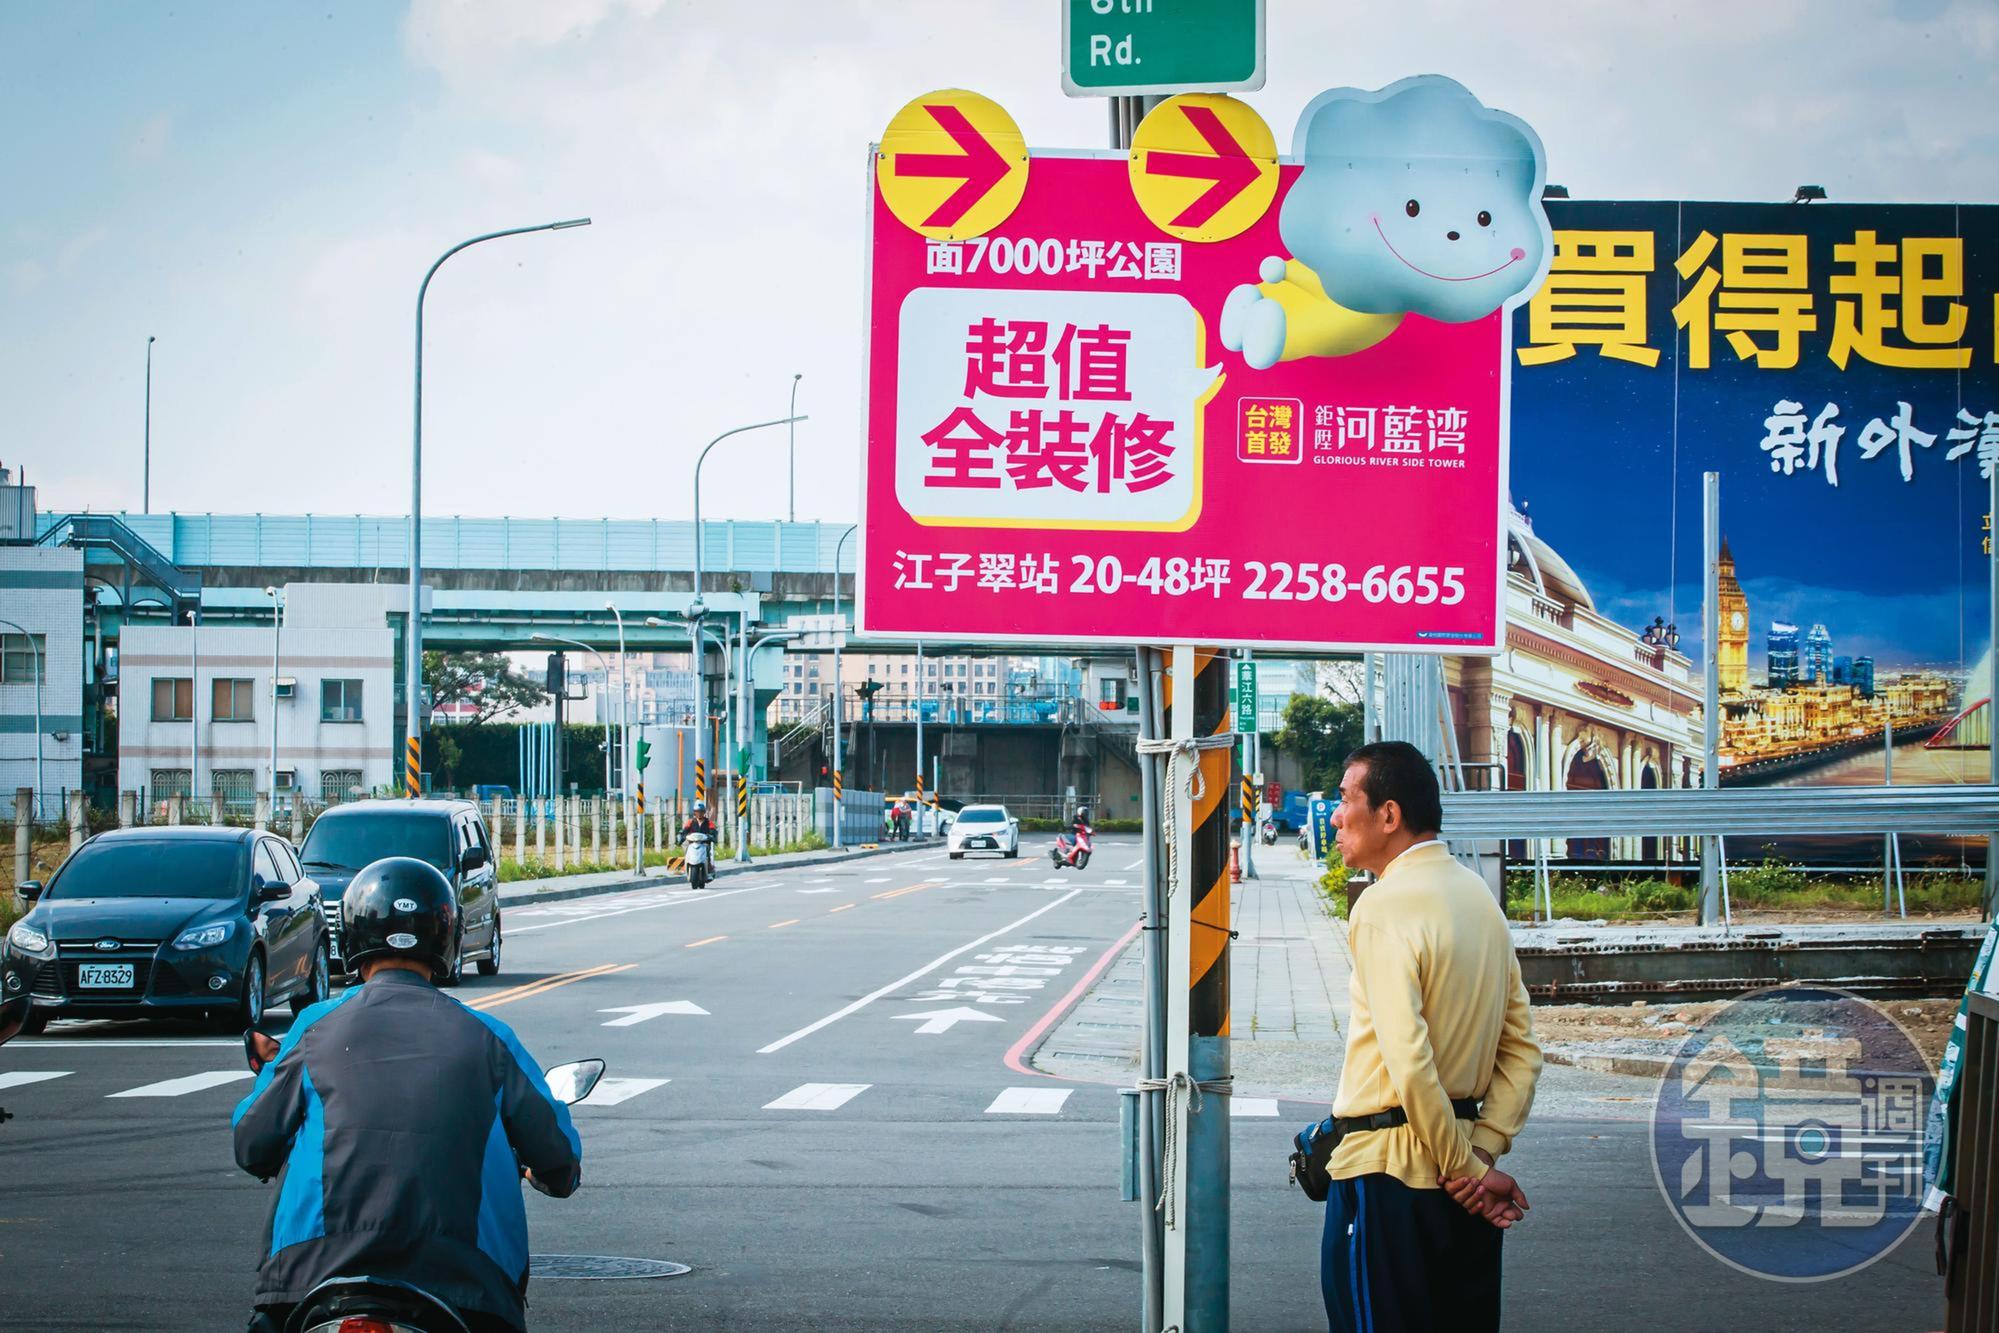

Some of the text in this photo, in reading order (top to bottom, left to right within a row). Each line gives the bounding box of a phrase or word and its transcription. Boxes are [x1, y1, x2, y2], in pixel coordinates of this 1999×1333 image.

[1090, 34, 1141, 66] Rd.
[926, 237, 1182, 281] 面7000坪公園
[1516, 230, 1999, 371] 買得起
[963, 317, 1132, 401] 超值
[1245, 404, 1293, 430] 台灣
[920, 407, 1176, 493] 全裝修
[1245, 431, 1292, 455] 首發
[1313, 455, 1465, 469] GLORIOUS RIVER SIDE TOWER
[893, 550, 1465, 606] 江子翠站 20-48坪 2258-6655
[80, 969, 133, 984] AFZ-8329
